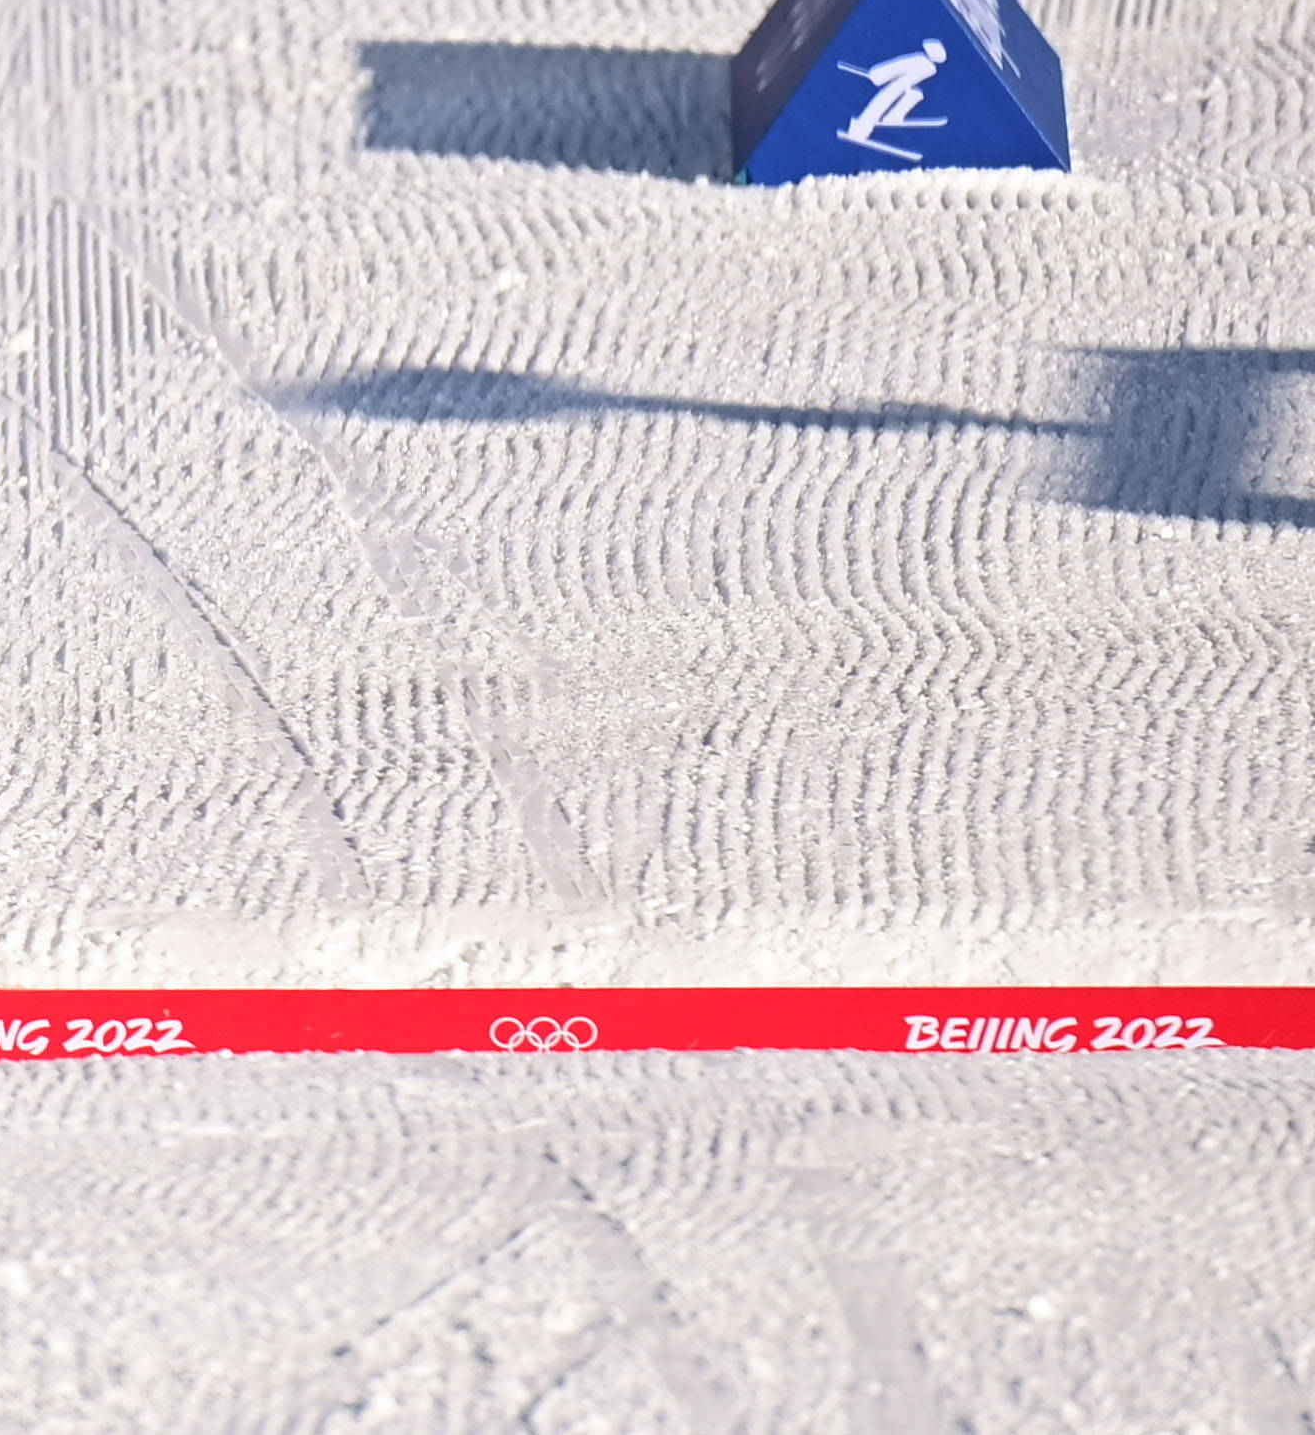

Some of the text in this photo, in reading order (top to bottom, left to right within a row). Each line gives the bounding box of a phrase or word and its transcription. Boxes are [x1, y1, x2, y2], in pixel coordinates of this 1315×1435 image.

[62, 1017, 197, 1054] 2022
[903, 1015, 1228, 1053] BEIJING 2022
